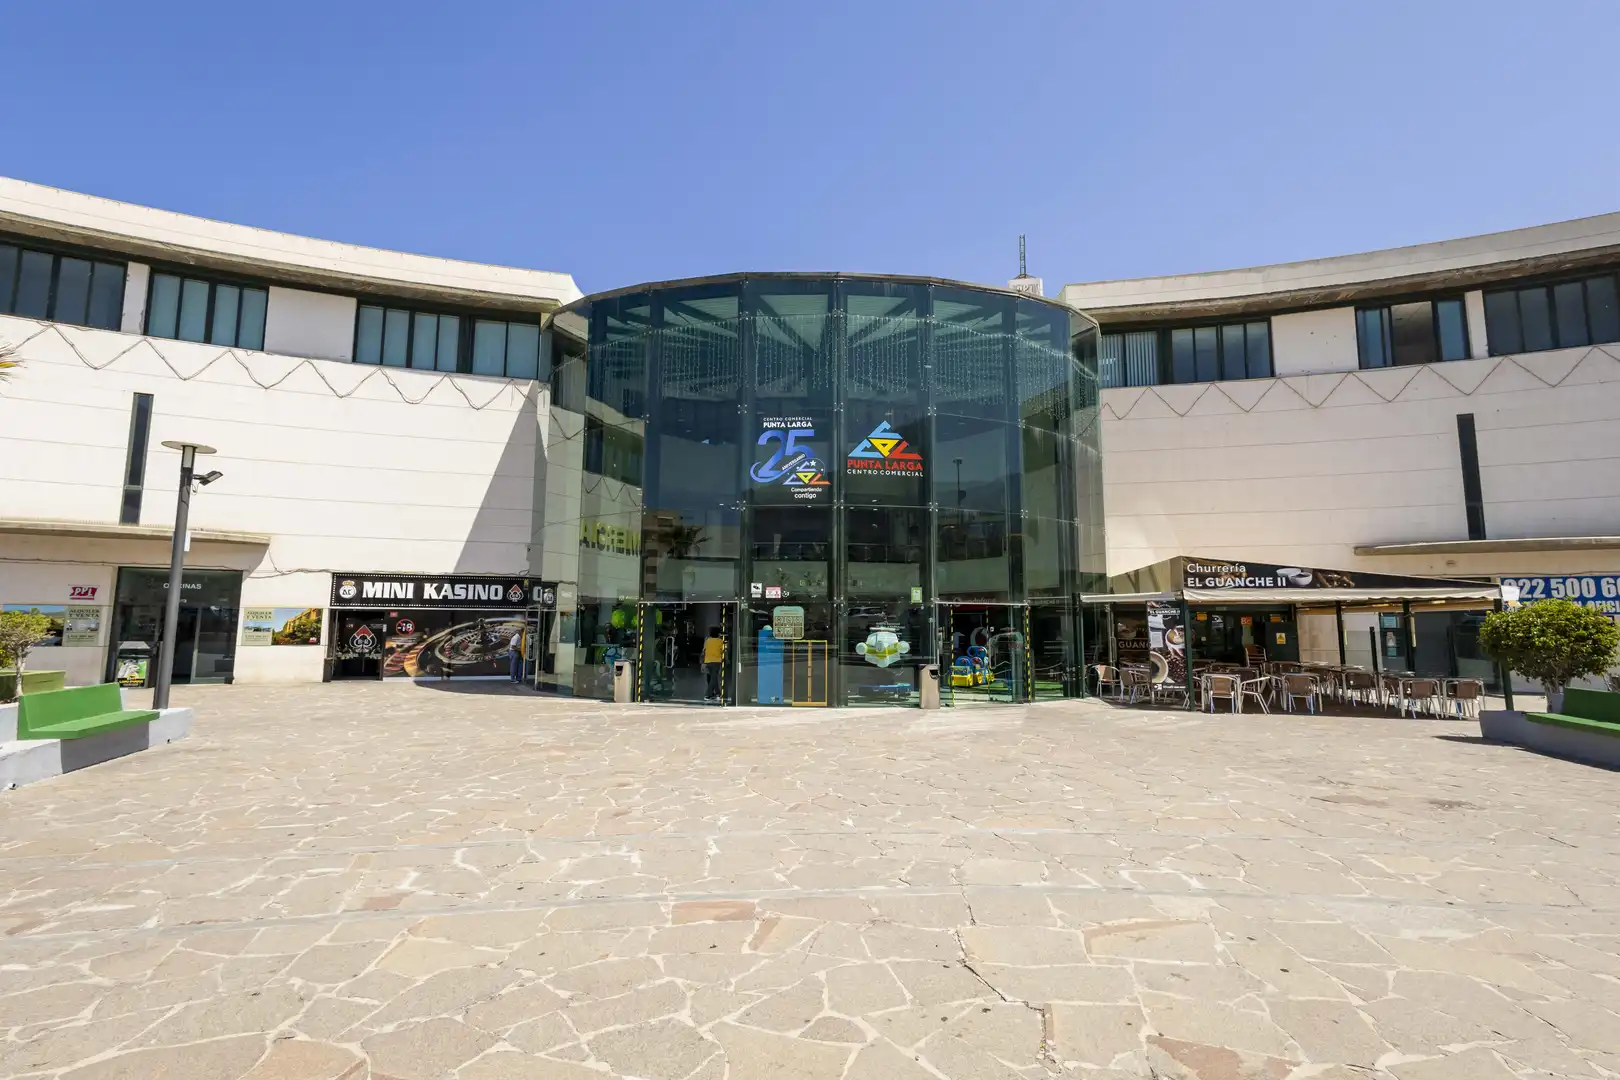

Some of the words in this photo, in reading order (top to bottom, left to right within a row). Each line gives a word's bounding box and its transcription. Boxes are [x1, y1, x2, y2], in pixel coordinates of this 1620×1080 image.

[757, 429, 815, 478] 25
[847, 459, 882, 469] PUNTA
[885, 460, 924, 471] LARGA
[1187, 563, 1246, 573] Churrería
[1187, 577, 1203, 587] EL
[1205, 577, 1274, 587] GUANCHE
[1550, 578, 1596, 598] 500
[1601, 578, 1620, 598] 6
[362, 581, 414, 599] MINI
[423, 583, 503, 600] KASINO
